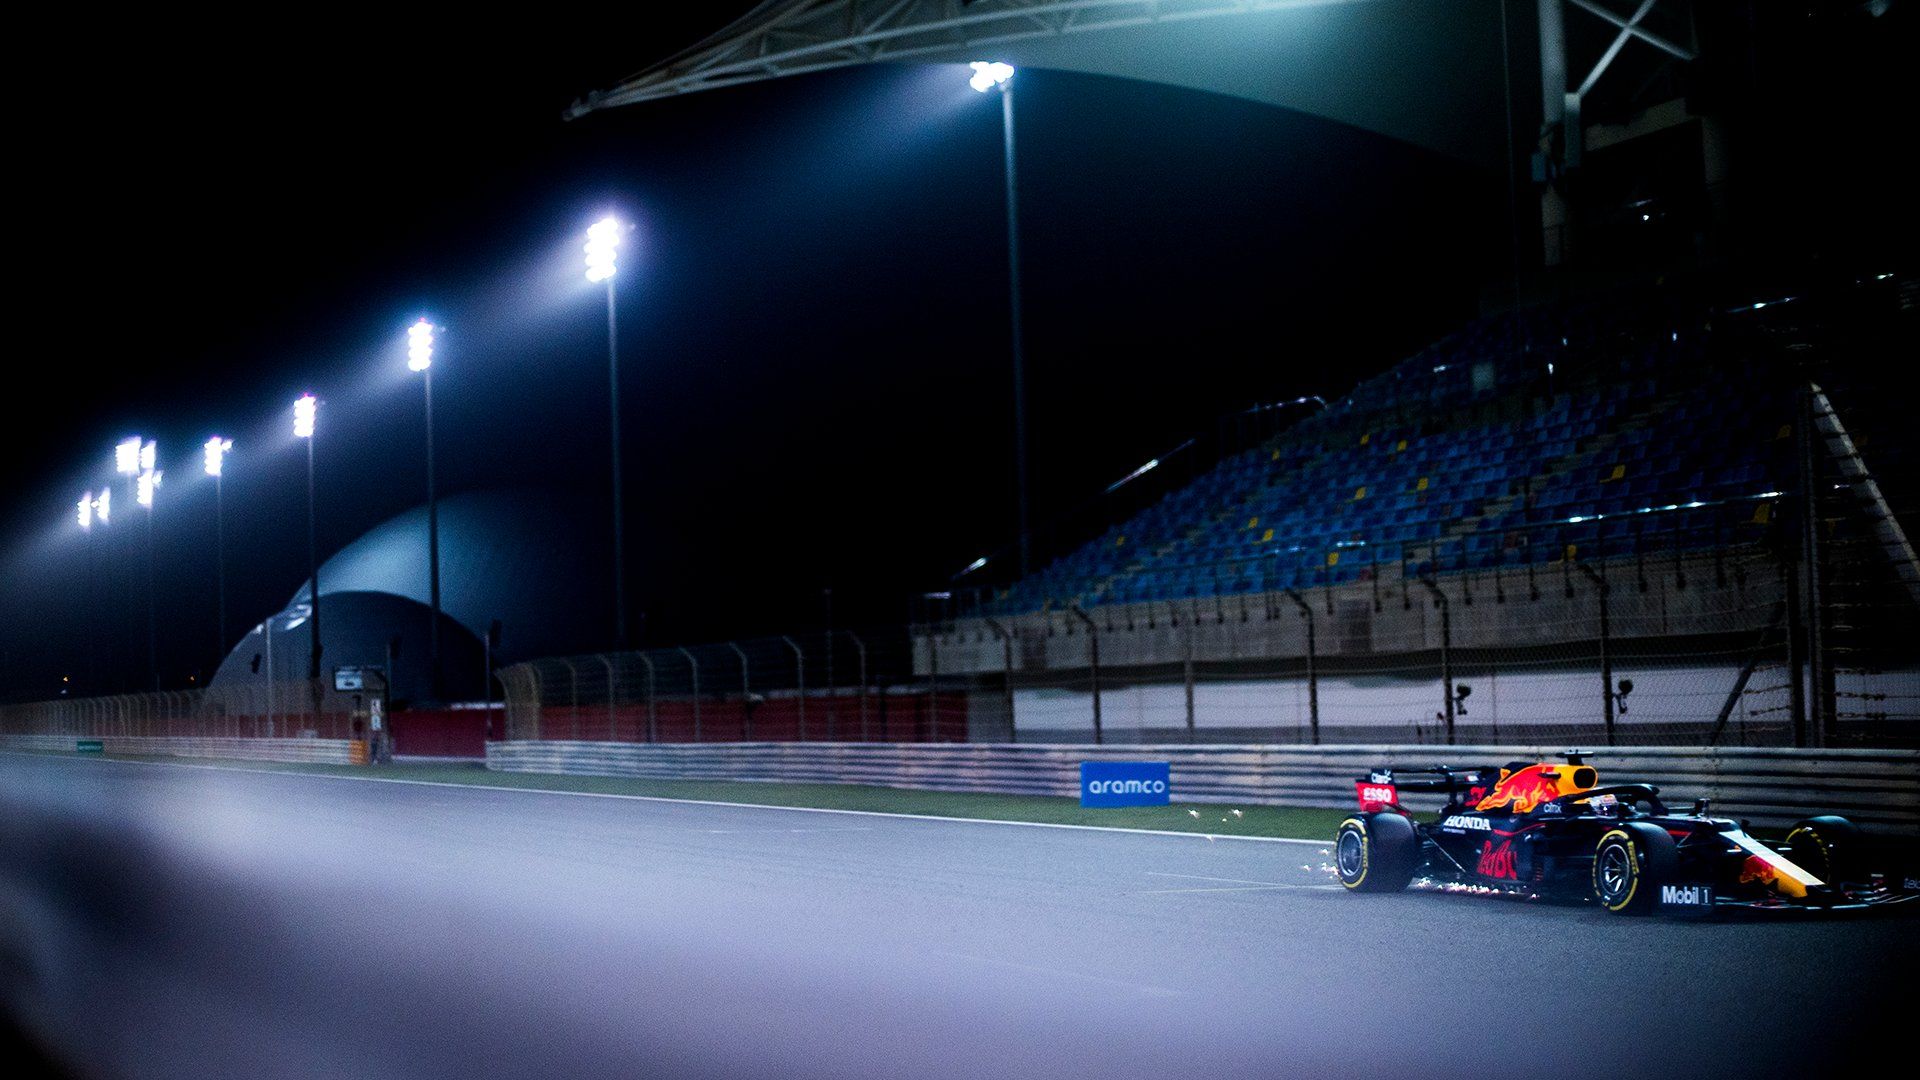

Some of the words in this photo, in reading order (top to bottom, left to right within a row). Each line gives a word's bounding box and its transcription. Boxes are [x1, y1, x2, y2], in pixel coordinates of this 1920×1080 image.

[1089, 779, 1166, 795] aramco
[1443, 815, 1491, 831] HONDA
[1662, 885, 1699, 905] Mobil
[1702, 889, 1709, 904] 1
